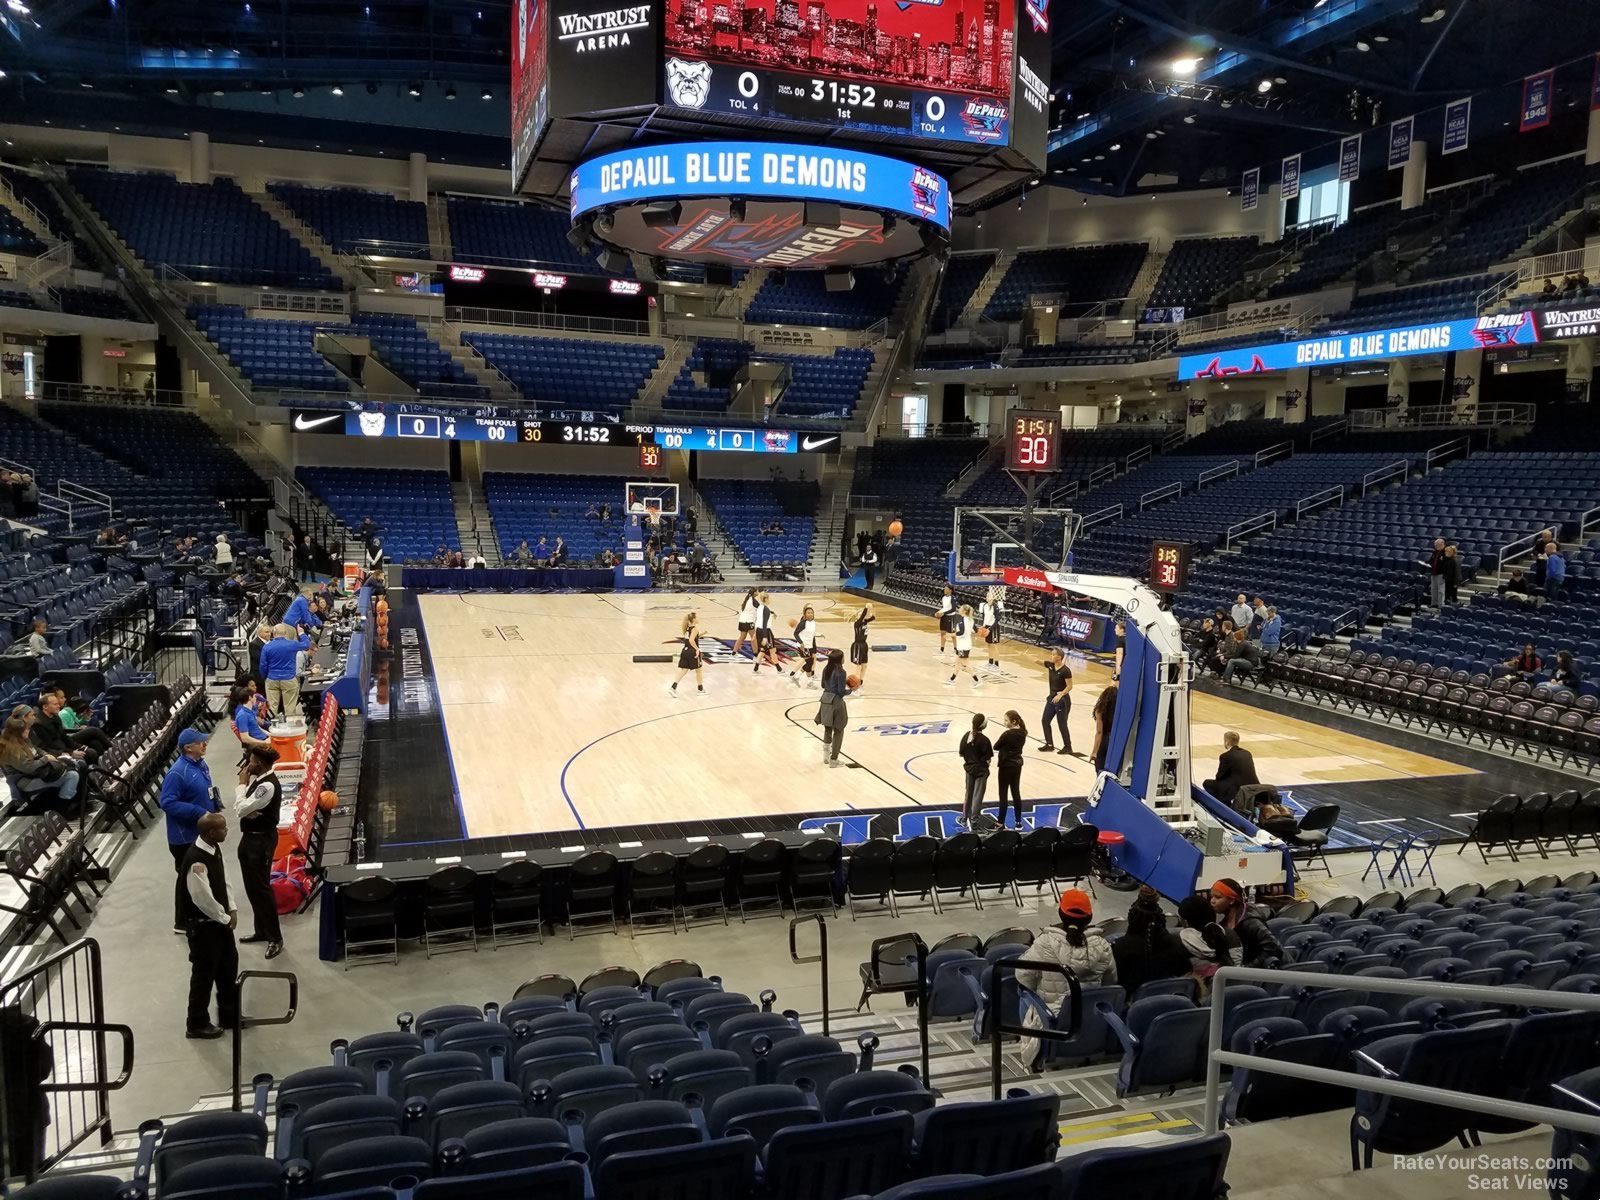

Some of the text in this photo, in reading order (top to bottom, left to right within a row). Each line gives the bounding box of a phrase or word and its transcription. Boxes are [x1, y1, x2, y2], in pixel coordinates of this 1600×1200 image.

[559, 5, 651, 35] WINTRUST
[576, 32, 630, 52] ARENA
[738, 71, 759, 97] 0
[794, 87, 805, 97] 00
[810, 79, 876, 108] 31:52
[729, 99, 759, 111] TOL 4
[883, 99, 894, 108] 00
[1024, 87, 1042, 113] ARENA
[837, 108, 851, 119] 1st
[926, 95, 946, 121] 0
[1523, 106, 1547, 120] 1945
[920, 122, 946, 134] TOL 4
[600, 152, 867, 194] DEPAUL BLUE DEMONS
[1545, 308, 1600, 325] WINTRUS
[1556, 324, 1597, 337] ARENA
[1297, 326, 1451, 363] DEPAUL BLUE DEMONS
[413, 419, 425, 434] 0
[475, 418, 517, 427] TEAM FOULS
[625, 425, 653, 433] PERIOD
[1017, 419, 1052, 435] 31:51
[445, 424, 456, 438] 4
[488, 426, 505, 440] 00
[525, 429, 541, 441] 30
[563, 426, 610, 442] 31:52
[656, 426, 693, 435] TEAM FOULS
[637, 434, 642, 444] 1
[665, 434, 683, 447] 00
[706, 436, 717, 449] 4
[733, 433, 742, 448] 0
[1020, 437, 1047, 464] 30
[644, 454, 657, 466] 30
[1058, 574, 1079, 583] SPALDING
[1161, 565, 1176, 583] 30
